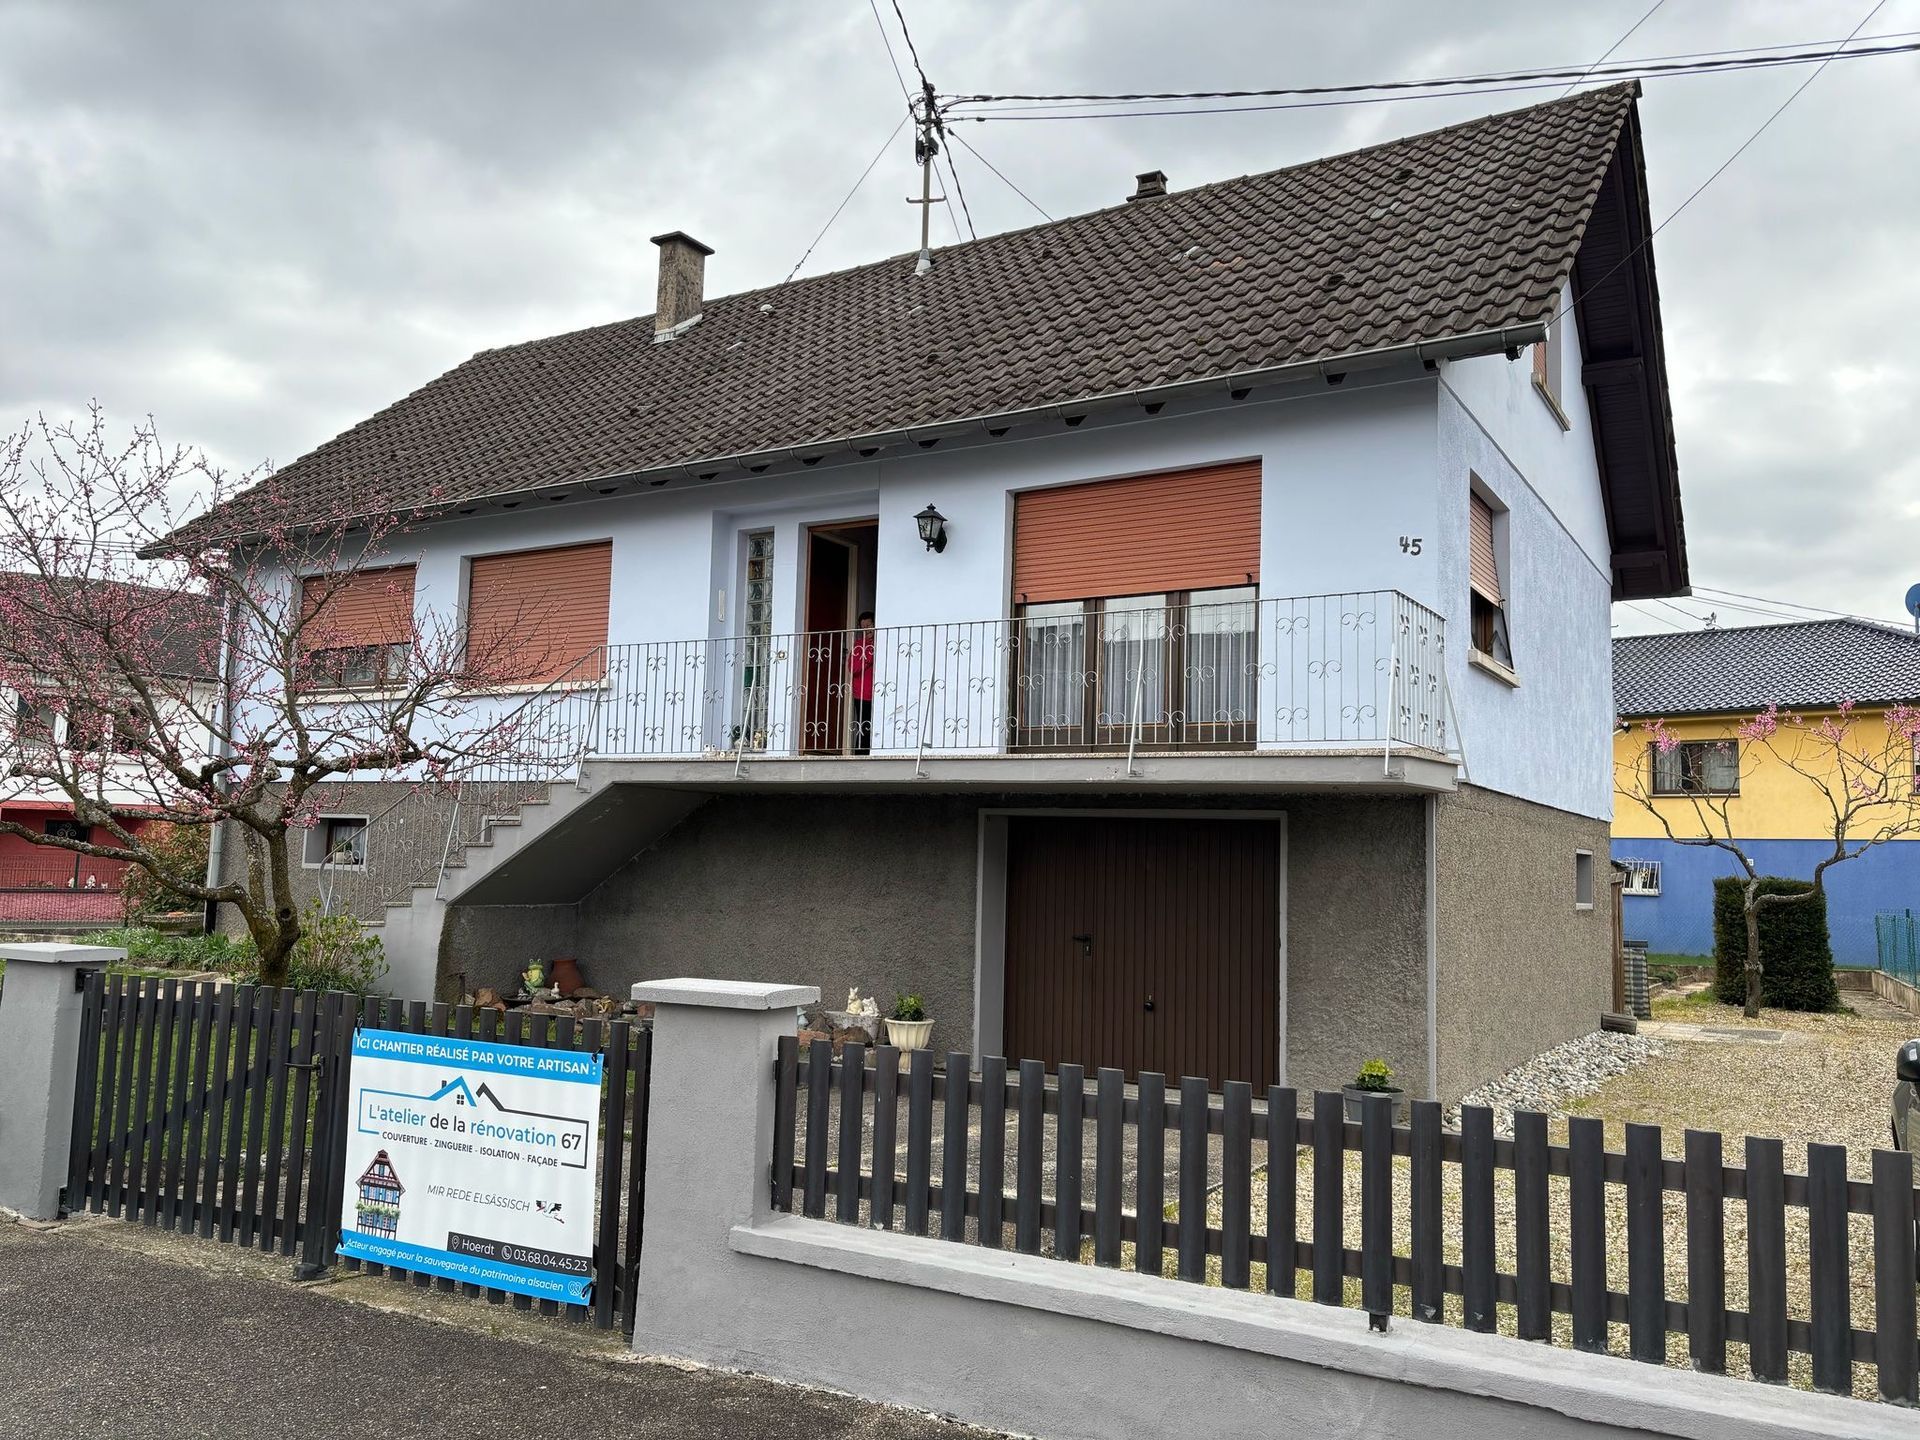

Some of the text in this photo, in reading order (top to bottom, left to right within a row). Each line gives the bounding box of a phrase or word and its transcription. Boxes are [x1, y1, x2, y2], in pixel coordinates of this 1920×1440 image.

[1399, 536, 1422, 556] 45
[356, 1037, 370, 1049] ICI
[372, 1040, 424, 1056] CHANTIER
[426, 1043, 469, 1061] RÉALISÉ
[471, 1050, 494, 1064] PAR
[496, 1053, 535, 1069] VOTRE
[537, 1059, 590, 1075] ARTISAN
[369, 1104, 582, 1151] L'atelier de la rénovation 67
[382, 1131, 428, 1146] COUVERTURE
[434, 1139, 473, 1153] ZINGUERIE
[479, 1146, 520, 1161] ISOLATION
[527, 1154, 559, 1168] FAÇADE
[427, 1184, 445, 1198] MIR
[446, 1187, 472, 1202] REDE
[345, 1238, 564, 1292] Acteur engagé pour la sauvegarde du patrimoine alsacien
[462, 1238, 588, 1272] Hoerdt 03.68.04.45.23
